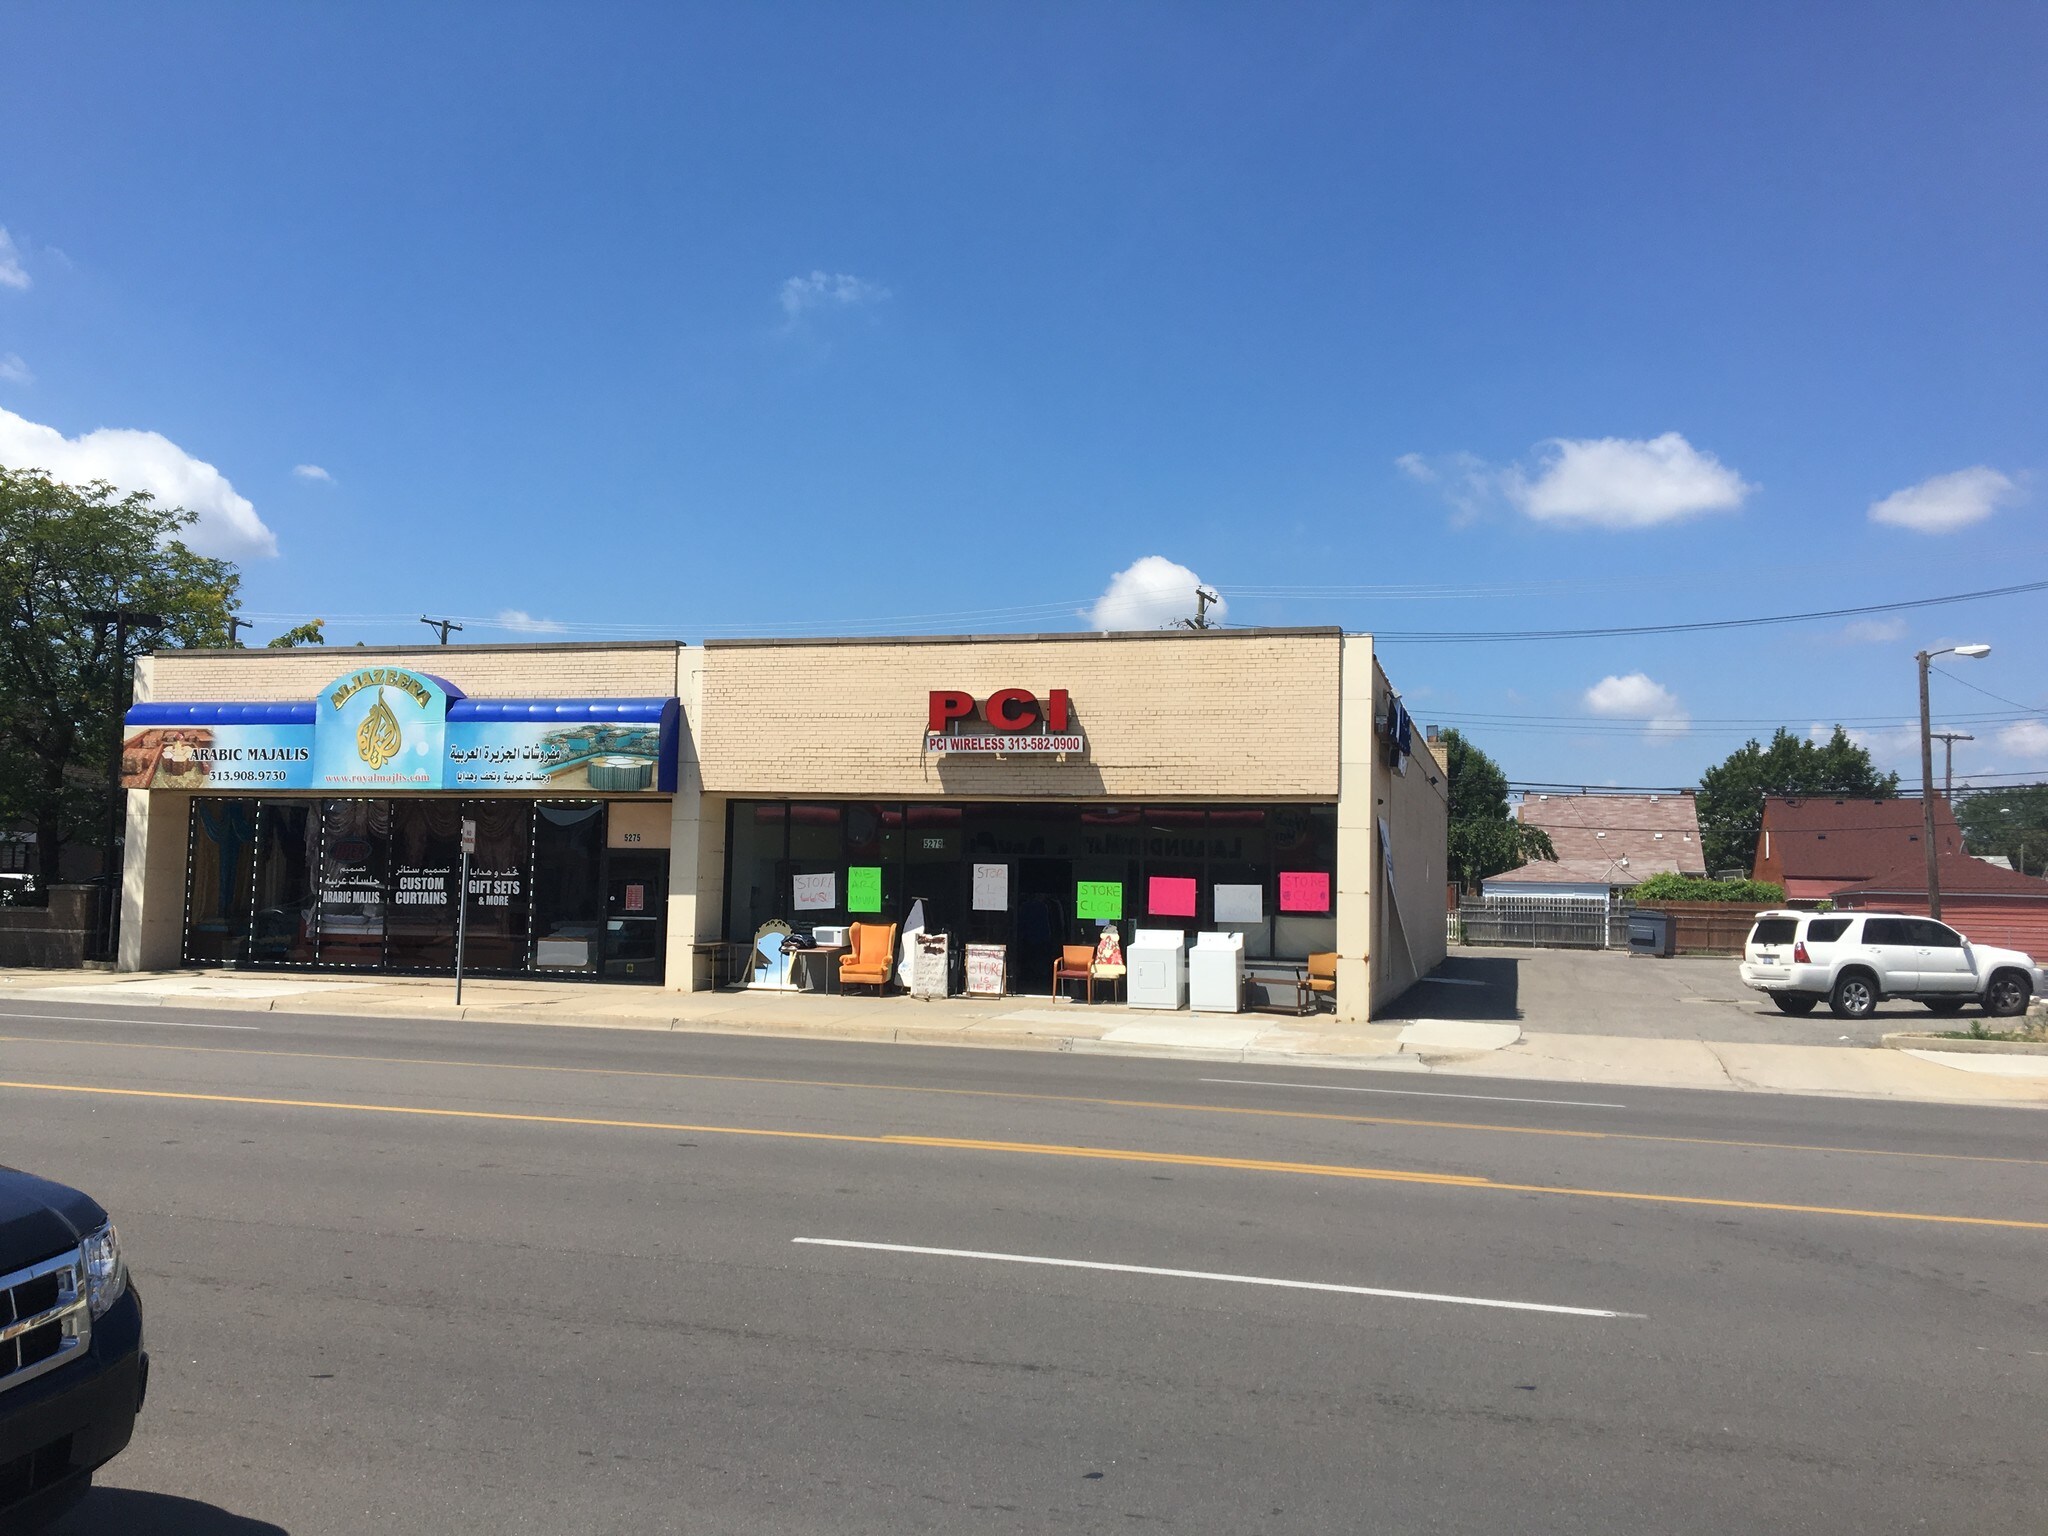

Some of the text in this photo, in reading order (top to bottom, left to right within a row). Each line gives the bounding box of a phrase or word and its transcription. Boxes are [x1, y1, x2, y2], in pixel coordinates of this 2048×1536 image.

[929, 688, 1069, 731] PCI
[929, 738, 1080, 750] PCI WIRELESS 313-582-0900
[190, 748, 309, 761] ARABIC MAJALIS
[450, 745, 482, 764] العربية
[484, 745, 520, 764] الجزيرة
[209, 771, 287, 781] 313.908.9730
[624, 833, 641, 842] 5275
[924, 839, 943, 848] 5279
[399, 877, 444, 890] CUSTOM
[468, 880, 520, 895] GIFT SETS
[1081, 884, 1121, 897] STORE
[322, 891, 380, 904] ARABIC MAJLIS
[395, 891, 447, 905] CURTAINS
[478, 895, 509, 906] & MORE
[969, 961, 1003, 976] STORE
[971, 983, 999, 991] HERE
